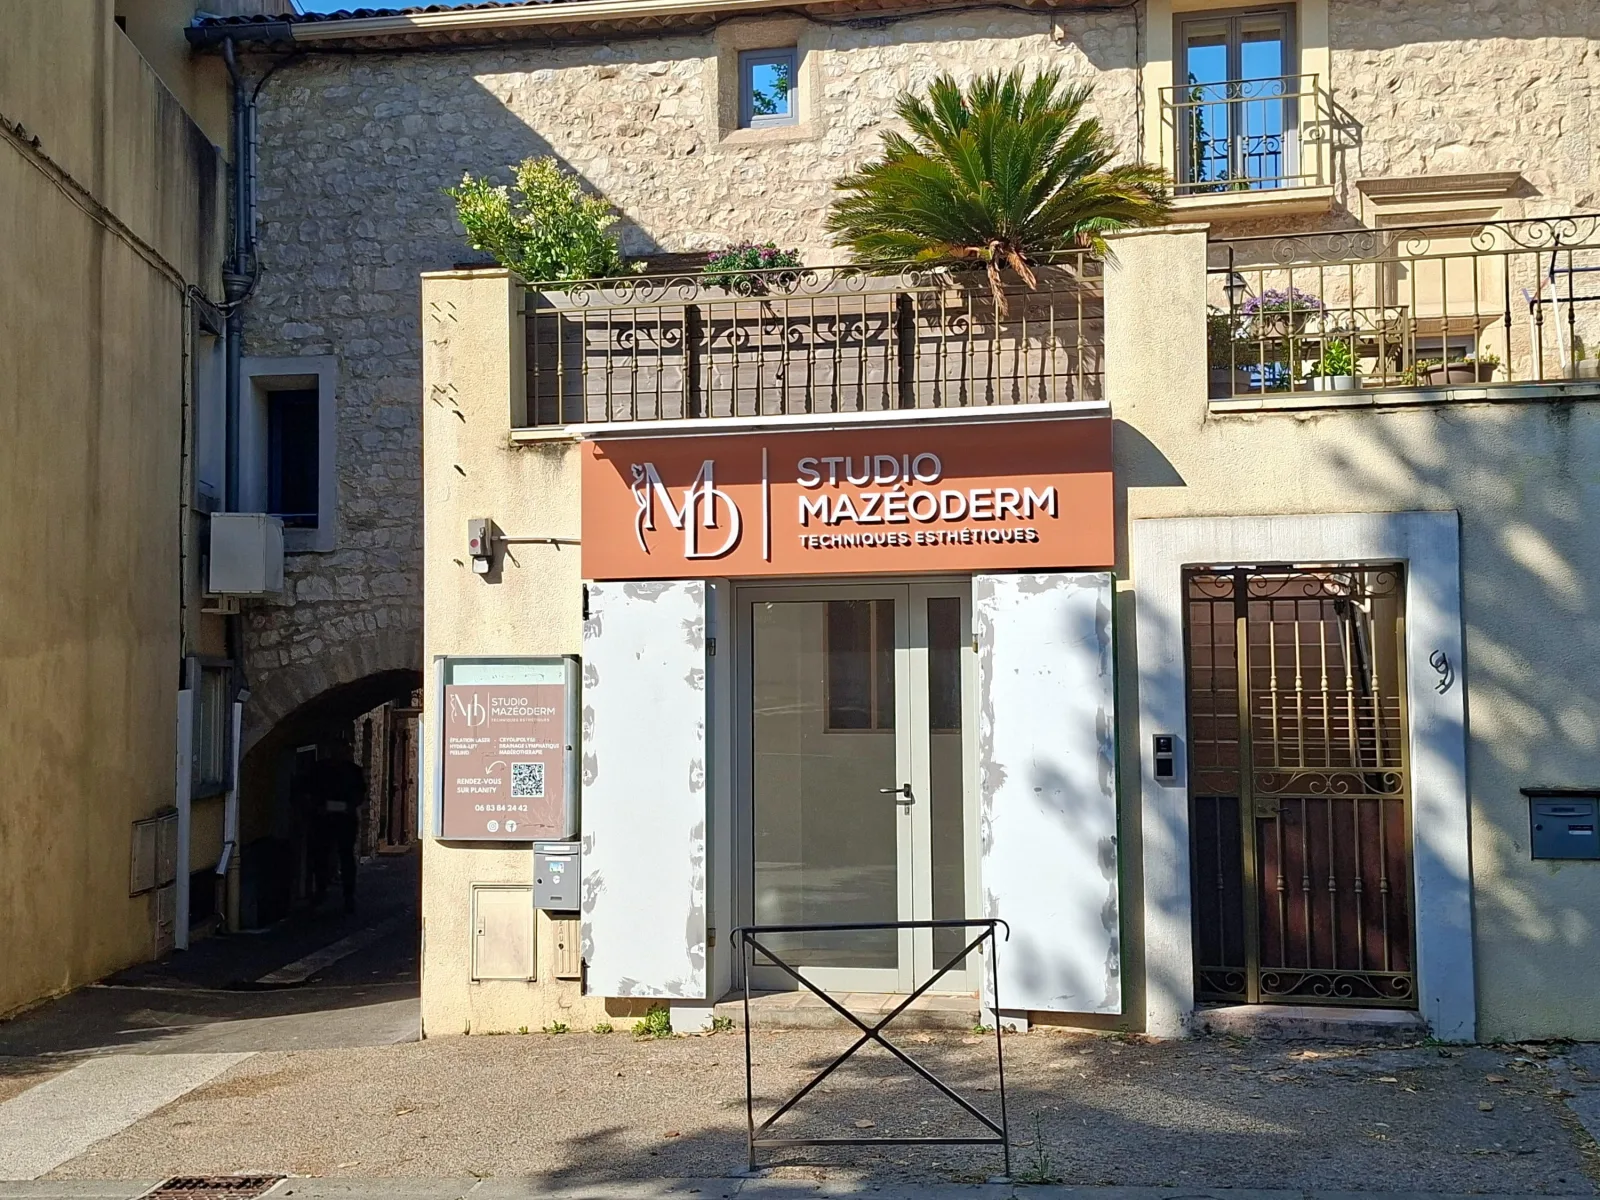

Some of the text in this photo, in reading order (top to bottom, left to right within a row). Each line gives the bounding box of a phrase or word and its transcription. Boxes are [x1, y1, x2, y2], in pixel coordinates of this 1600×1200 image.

[796, 452, 942, 488] STUDIO
[798, 484, 1056, 525] MAZÉODERM
[798, 526, 1037, 548] TECHNIQUES ESTHÉTIQUES
[491, 697, 528, 707] STUDIO
[491, 706, 556, 716] MAZÉODERM
[456, 777, 502, 785] RENDEZ-VOUS
[456, 786, 469, 794] SUR
[474, 804, 528, 812] 06 83 84 24 42
